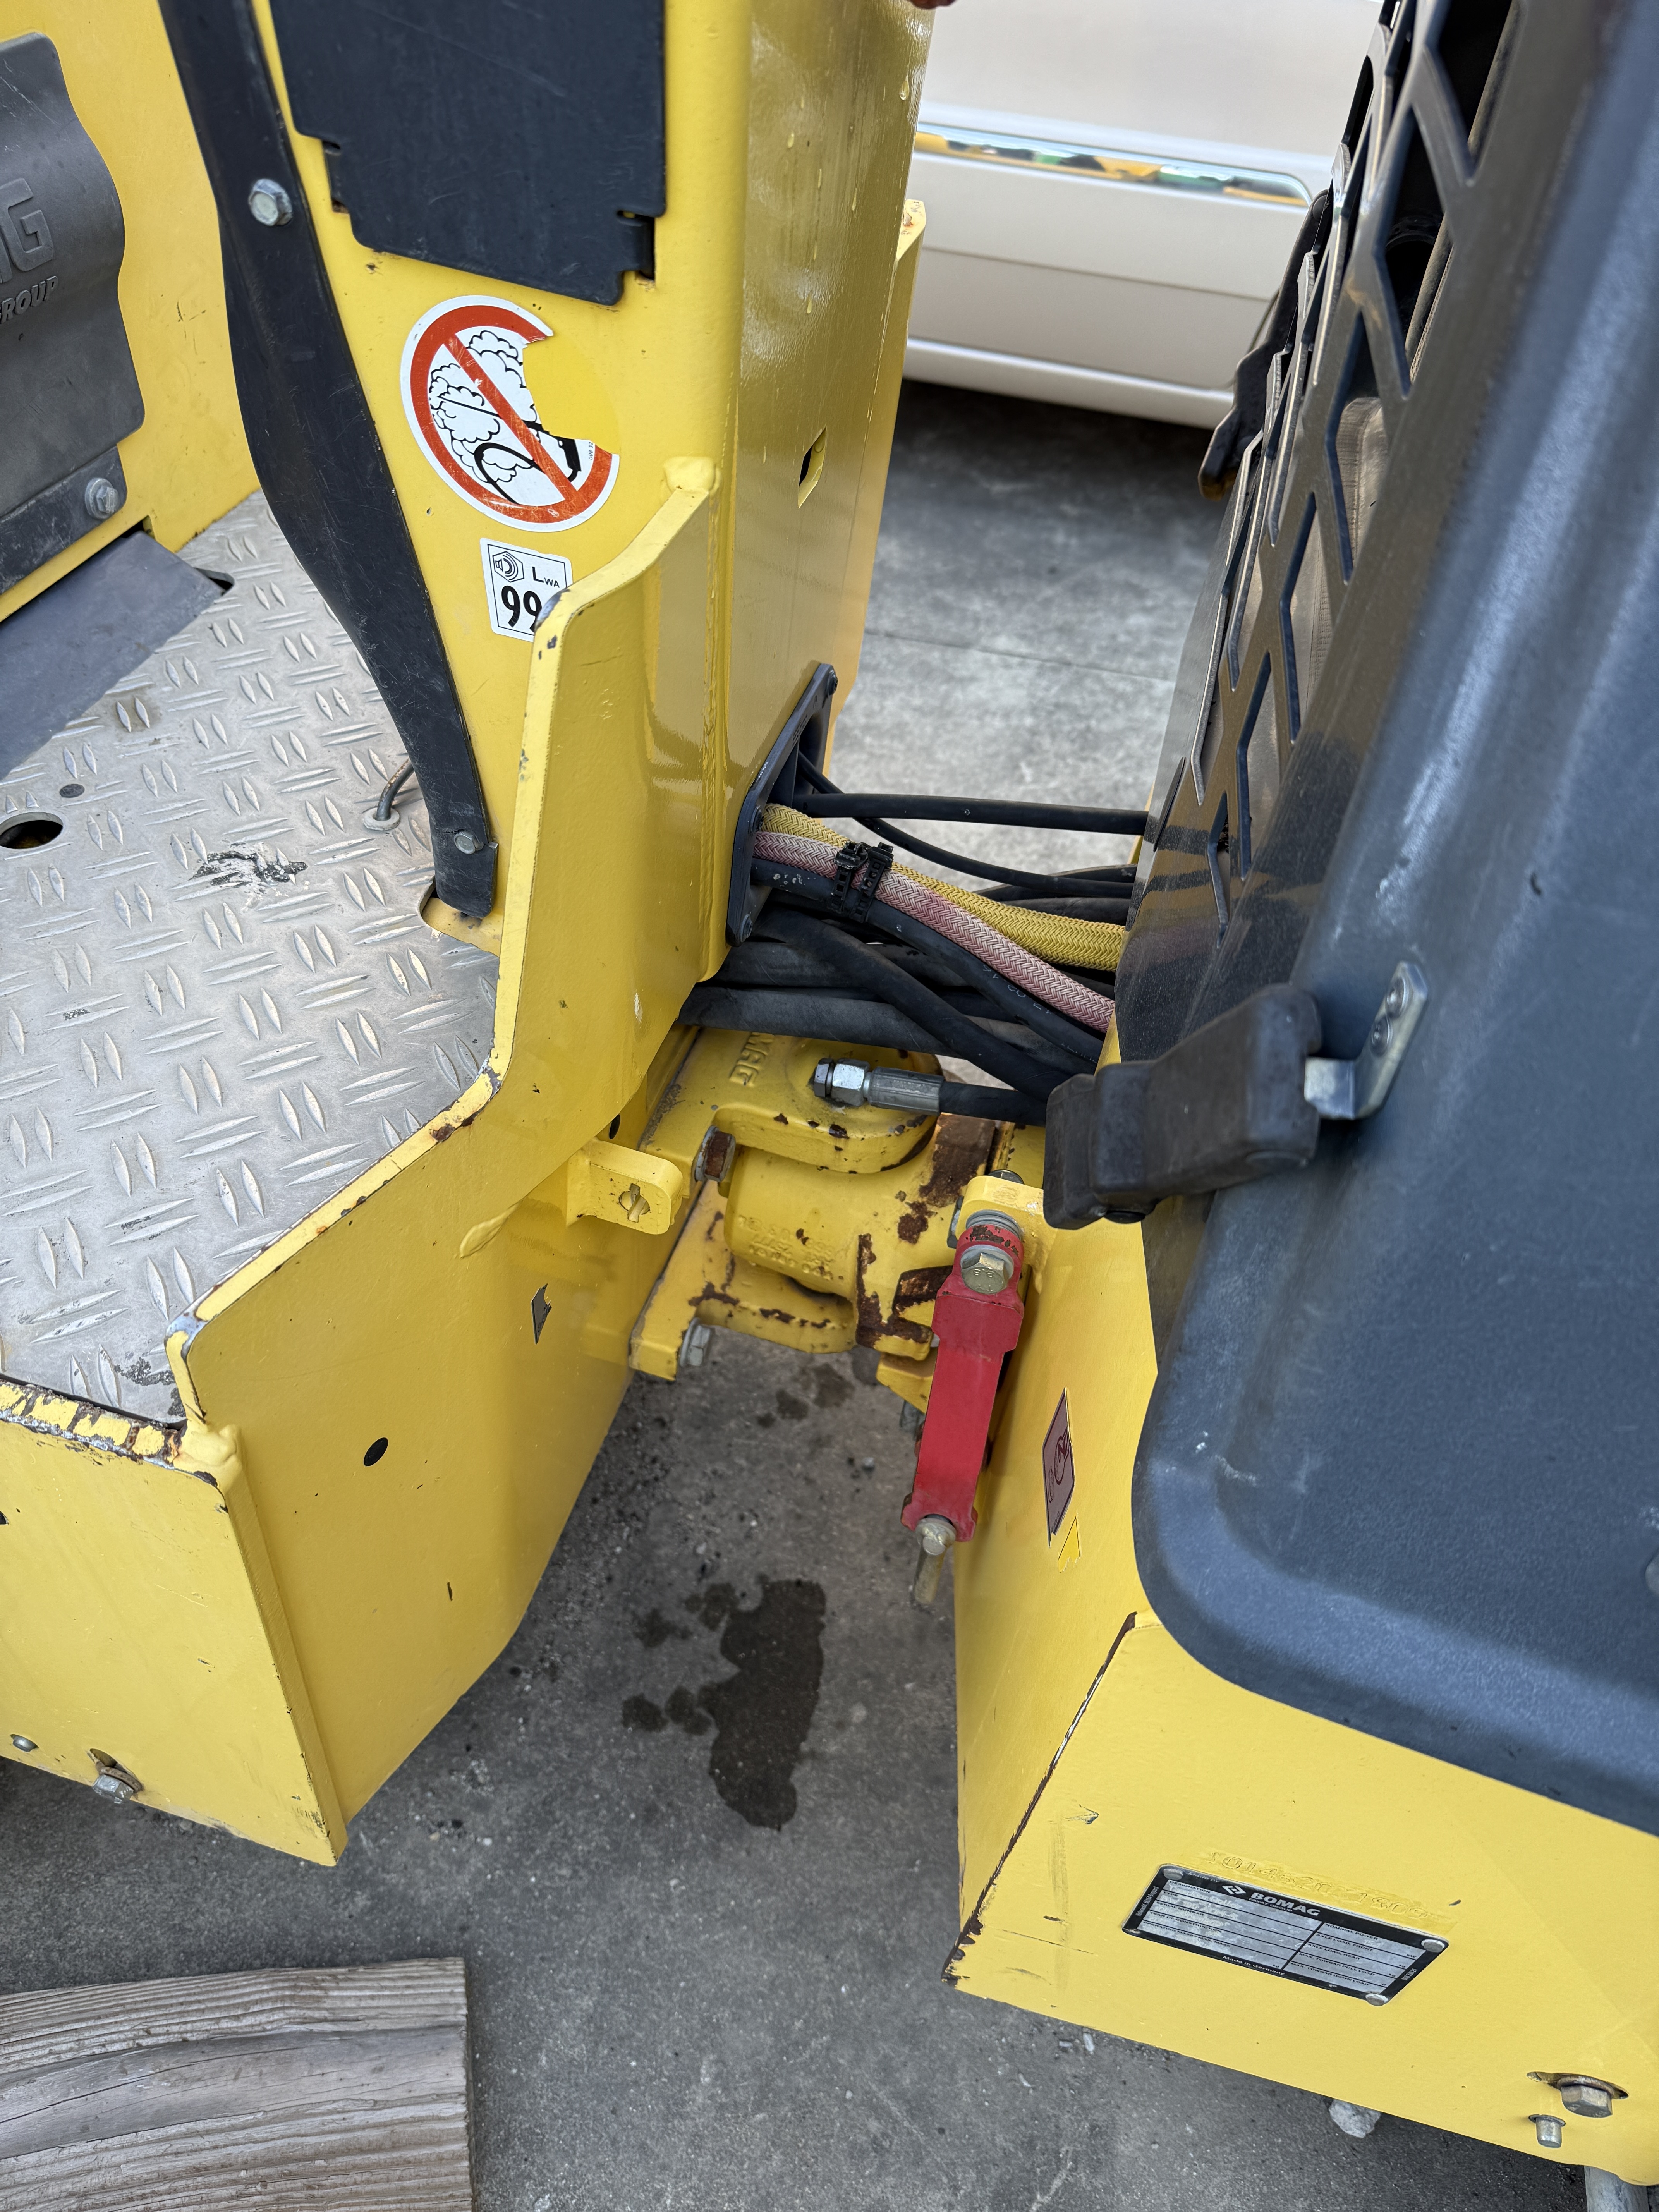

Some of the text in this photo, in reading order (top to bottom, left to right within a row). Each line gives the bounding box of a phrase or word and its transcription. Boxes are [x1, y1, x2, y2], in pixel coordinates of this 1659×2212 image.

[0, 177, 55, 283] G
[0, 275, 59, 324] ROUP
[501, 585, 542, 634] 99
[1170, 1881, 1210, 1893] DESIGNATION
[1249, 1892, 1322, 1916] BOMAG
[1178, 1907, 1204, 1916] NUMBER
[1144, 1921, 1176, 1932] OPERATING
[1175, 1918, 1222, 1933] CONSTRUCTION
[1325, 1924, 1354, 1933] NOMINAL
[1316, 1958, 1341, 1966] TOWBAR
[1252, 1964, 1285, 1976] Germany
[1307, 1967, 1332, 1975] TOWBAR
